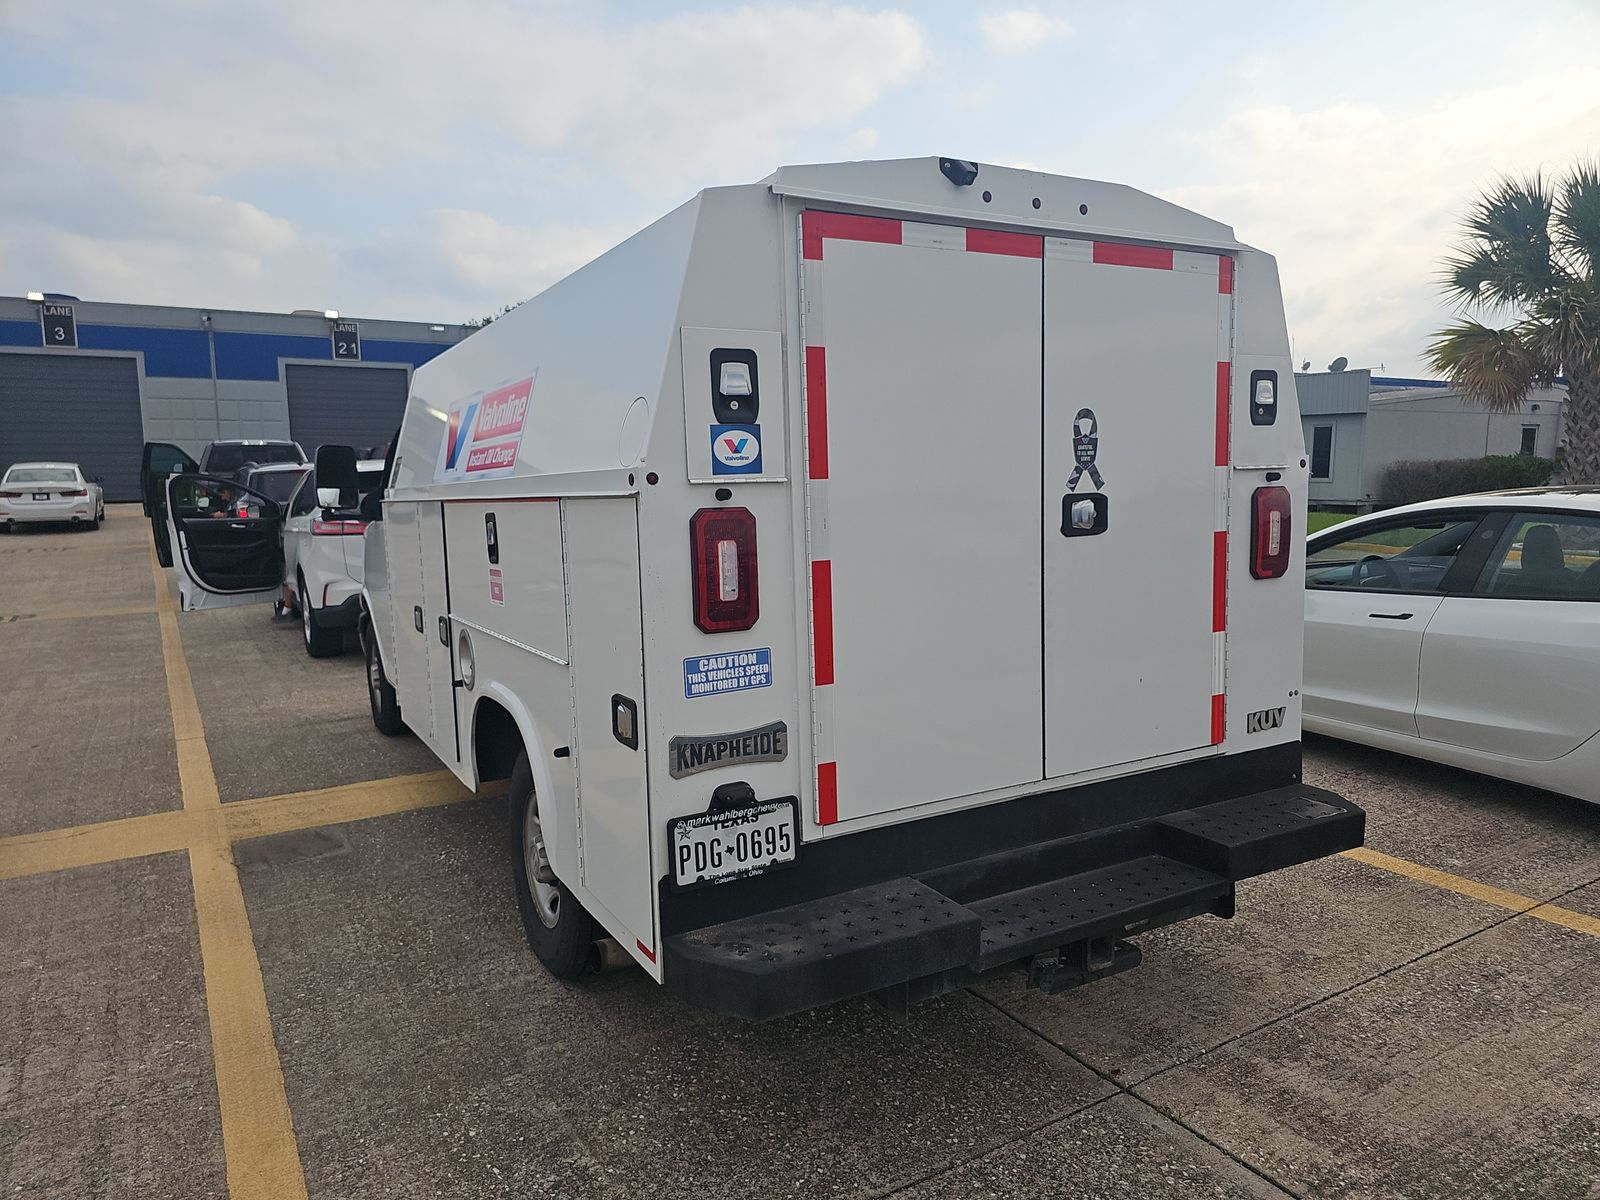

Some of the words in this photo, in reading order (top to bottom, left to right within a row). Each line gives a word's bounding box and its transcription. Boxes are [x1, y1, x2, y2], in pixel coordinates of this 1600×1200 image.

[43, 305, 72, 316] LANE
[54, 326, 65, 341] 3
[334, 323, 357, 333] LANE
[479, 394, 528, 433] Valvoline
[468, 450, 488, 467] Instant
[485, 449, 495, 465] Oil
[492, 448, 515, 465] Change
[699, 653, 757, 671] CAUTION
[687, 673, 707, 684] THIS
[707, 666, 745, 681] VEHICLES
[745, 663, 769, 676] SPEED
[691, 678, 738, 694] MONITORED
[739, 676, 750, 687] BY
[751, 674, 766, 685] GPS
[1247, 706, 1287, 734] KUV
[676, 729, 783, 773] KNAPHEIDE
[748, 869, 764, 877] Ohio
